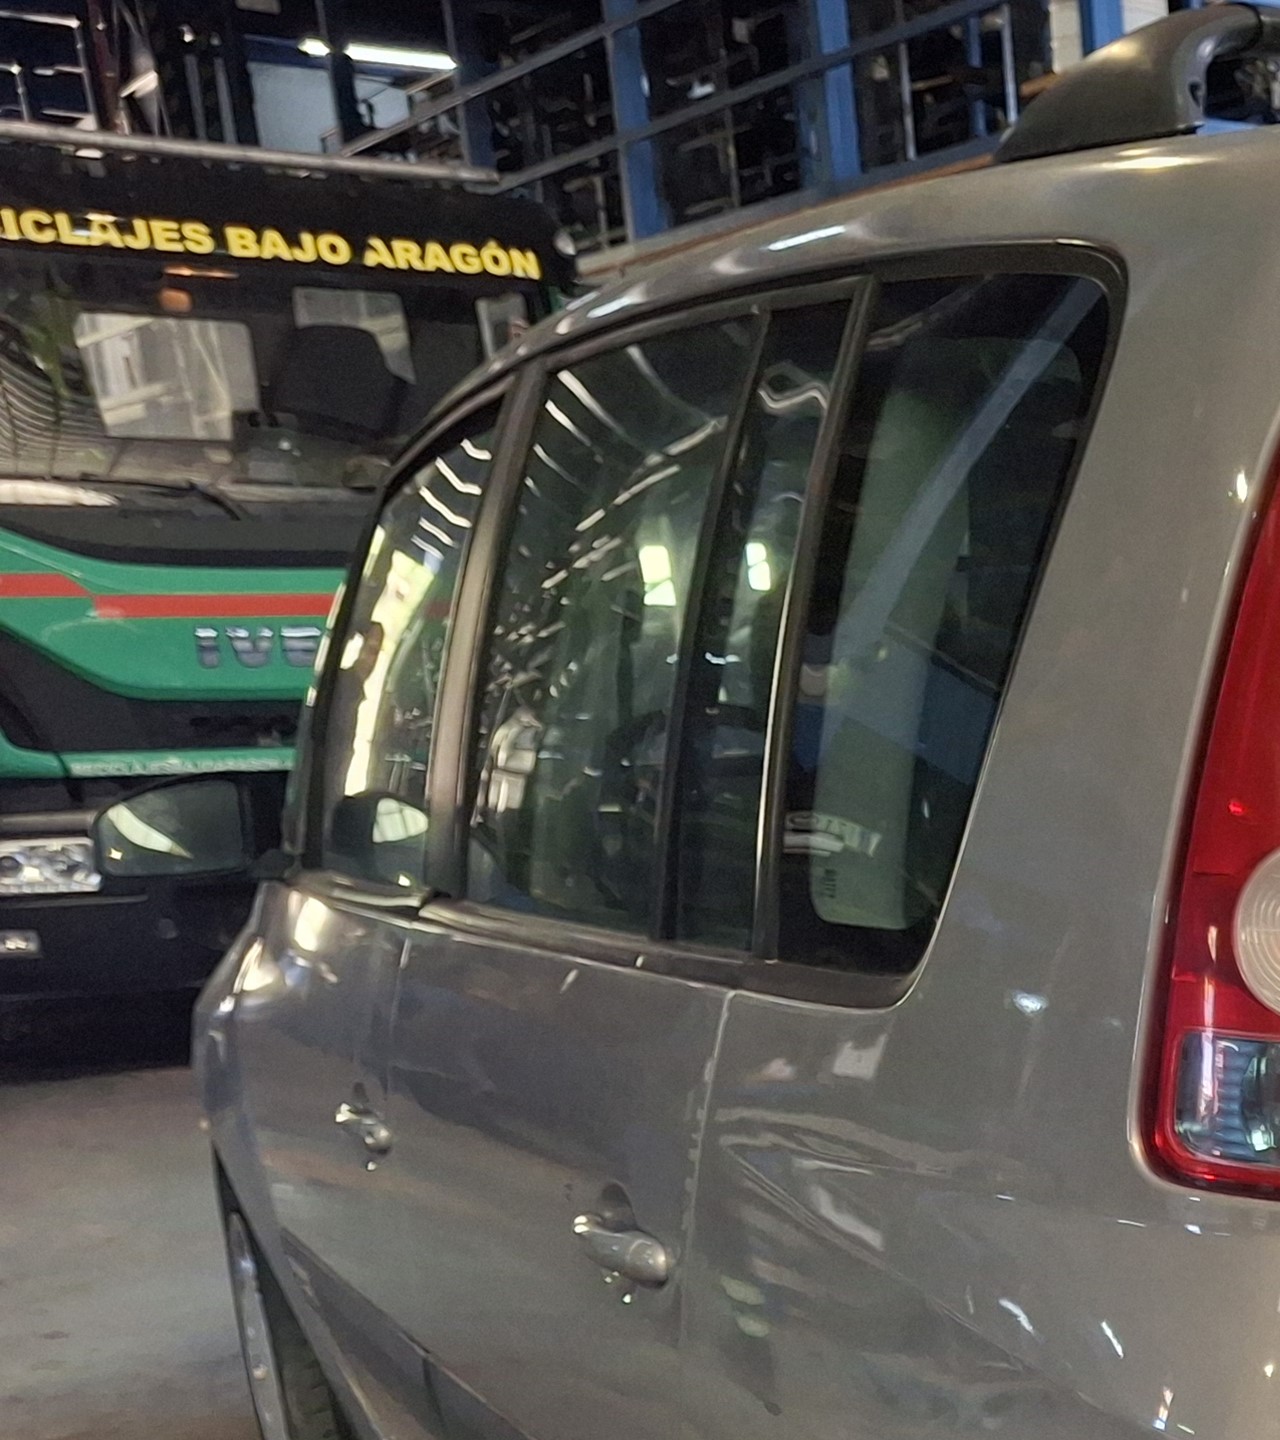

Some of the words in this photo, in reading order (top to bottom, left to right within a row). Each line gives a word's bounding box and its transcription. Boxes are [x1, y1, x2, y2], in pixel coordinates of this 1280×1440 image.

[0, 207, 216, 255] ICLAJES
[224, 225, 351, 266] BAJO
[362, 235, 540, 281] ARAGÓN
[194, 626, 321, 669] IVE
